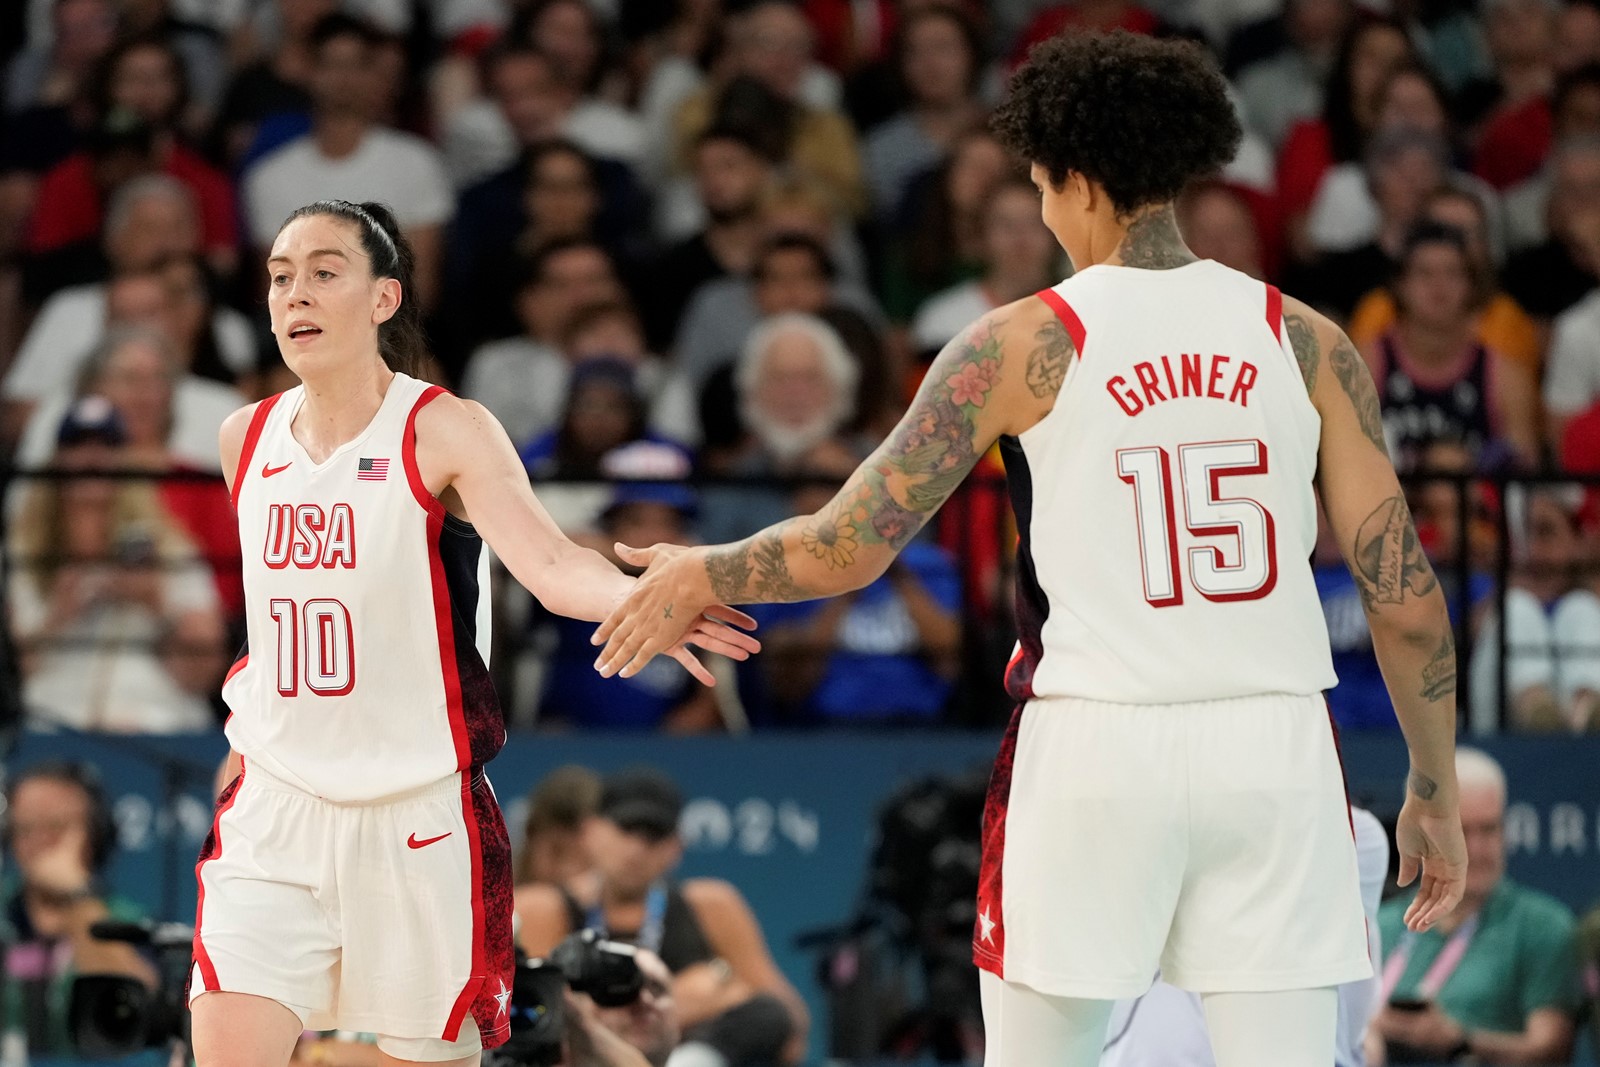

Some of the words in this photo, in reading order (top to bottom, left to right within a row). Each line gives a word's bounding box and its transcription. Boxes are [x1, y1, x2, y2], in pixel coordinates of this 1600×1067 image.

[1106, 354, 1258, 417] GRINER
[263, 503, 356, 570] USA
[1116, 438, 1278, 608] 15
[270, 598, 356, 697] 10
